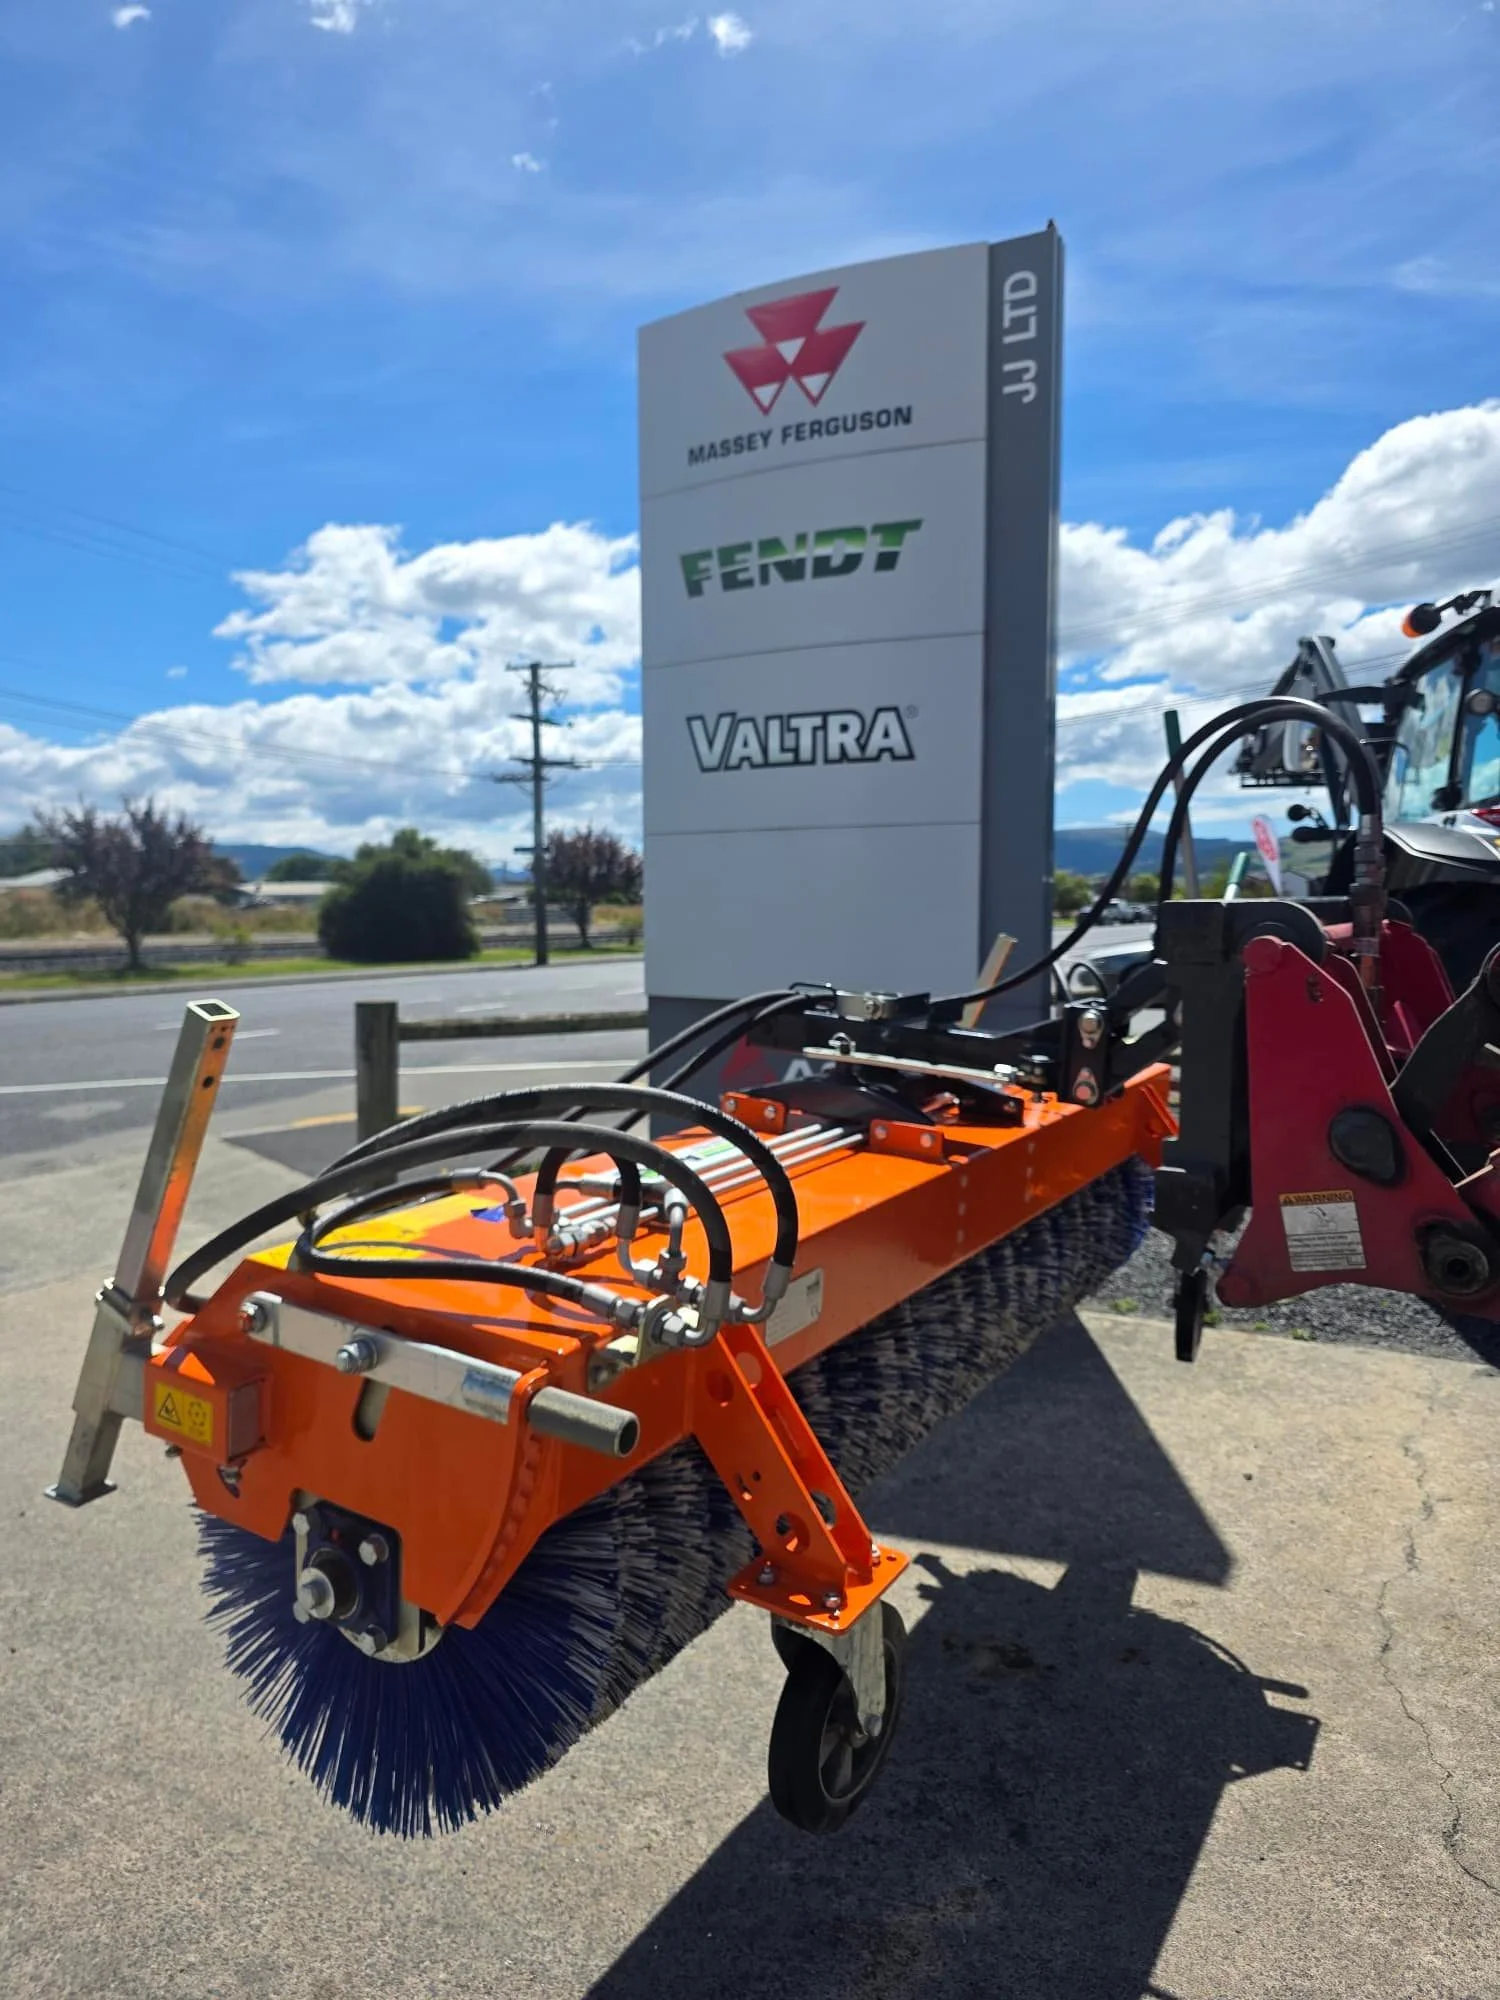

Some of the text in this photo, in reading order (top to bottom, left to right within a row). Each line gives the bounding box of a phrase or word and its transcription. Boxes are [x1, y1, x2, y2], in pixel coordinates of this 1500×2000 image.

[1002, 270, 1037, 404] JJ LTD
[688, 405, 913, 467] MASSEY FERGUSON
[679, 518, 924, 599] FENDT
[1294, 1191, 1353, 1205] WARNING
